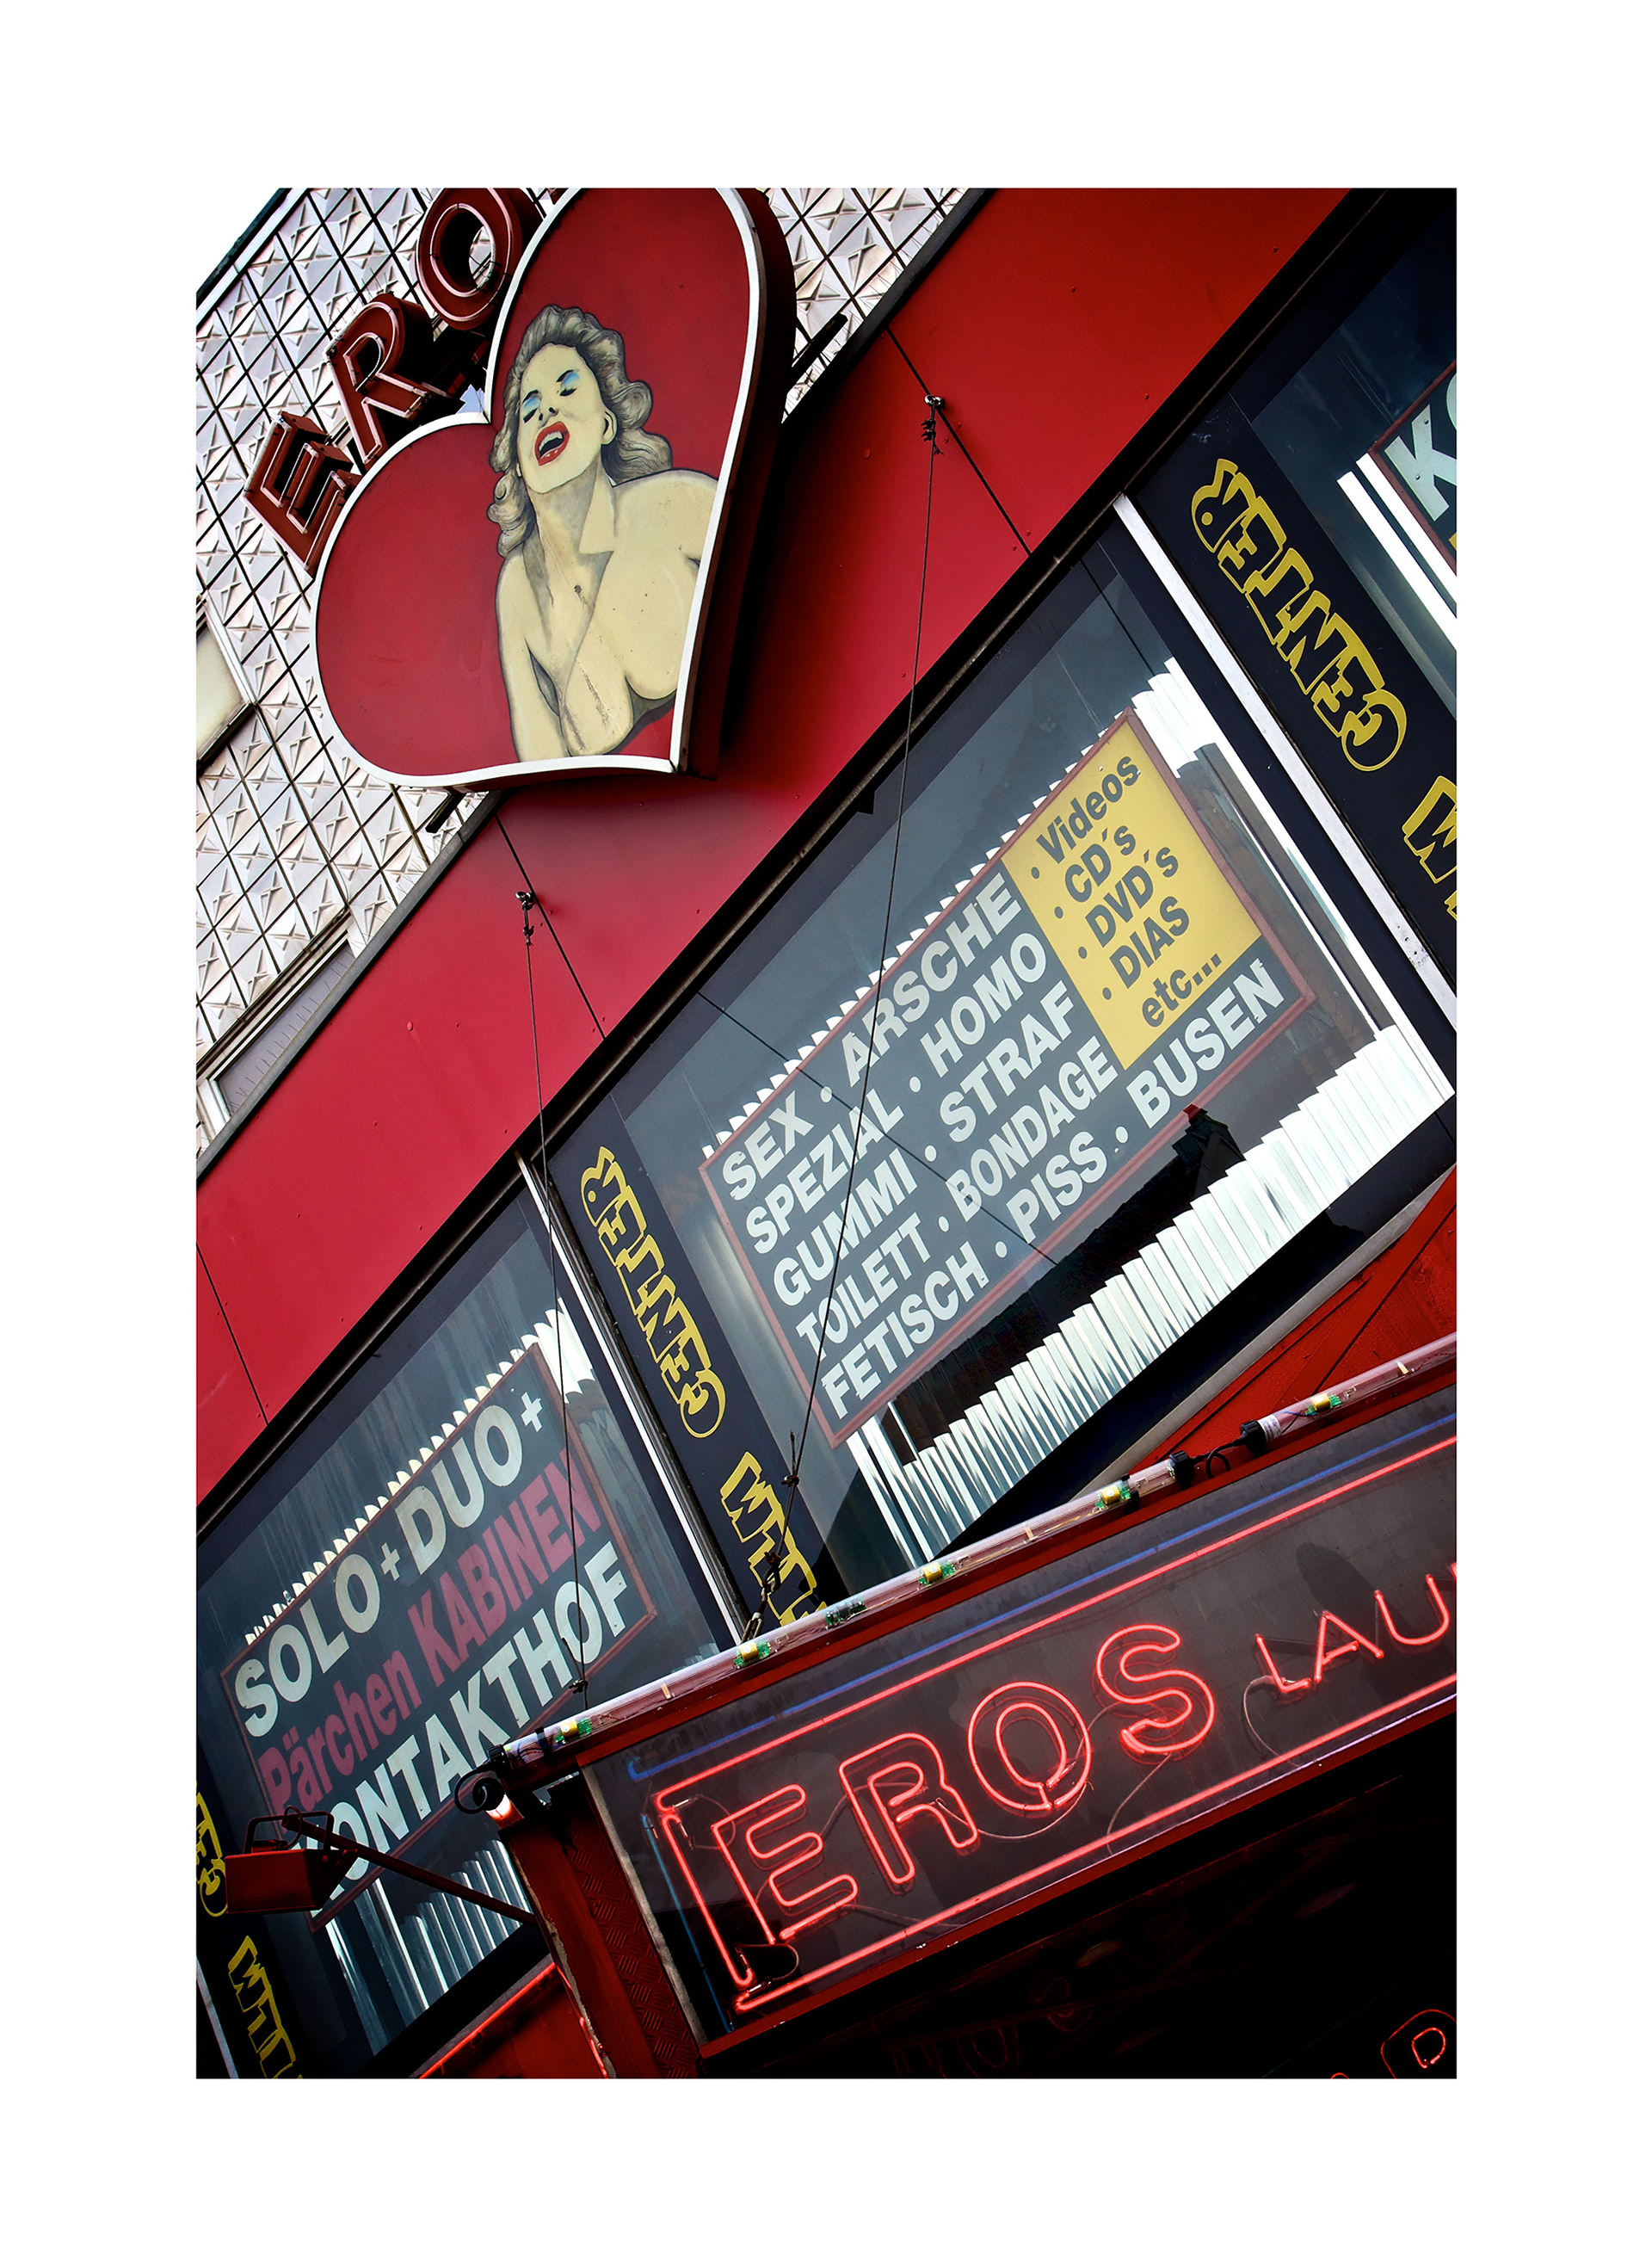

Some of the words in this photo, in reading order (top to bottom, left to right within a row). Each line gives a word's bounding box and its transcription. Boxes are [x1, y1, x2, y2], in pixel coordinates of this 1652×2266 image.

[243, 188, 539, 576] ERO
[1191, 458, 1407, 773] CENTER
[1036, 754, 1141, 863] Videos
[1109, 896, 1191, 989] DIAS
[722, 1090, 814, 1202] SEX
[745, 1087, 905, 1255] SPEZIAL
[920, 932, 1047, 1078] HOMO
[774, 1147, 918, 1307] GUMMI
[940, 979, 1075, 1143] STRAF
[797, 1212, 933, 1361] TOILETT
[946, 1035, 1119, 1222] BONDAGE
[820, 1240, 989, 1419] FETISCH
[1005, 1130, 1108, 1244] PISS
[1125, 958, 1285, 1127] BUSEN
[580, 1145, 727, 1439] CENTER
[234, 1553, 381, 1738] SOLO
[393, 1405, 524, 1577] DUO
[256, 1647, 422, 1833] Pärchen
[406, 1448, 603, 1688] KABINEN
[289, 1541, 628, 1917] ONTAKTHOF
[711, 1621, 1215, 1945] EROS
[1254, 1562, 1457, 1694] LAU
